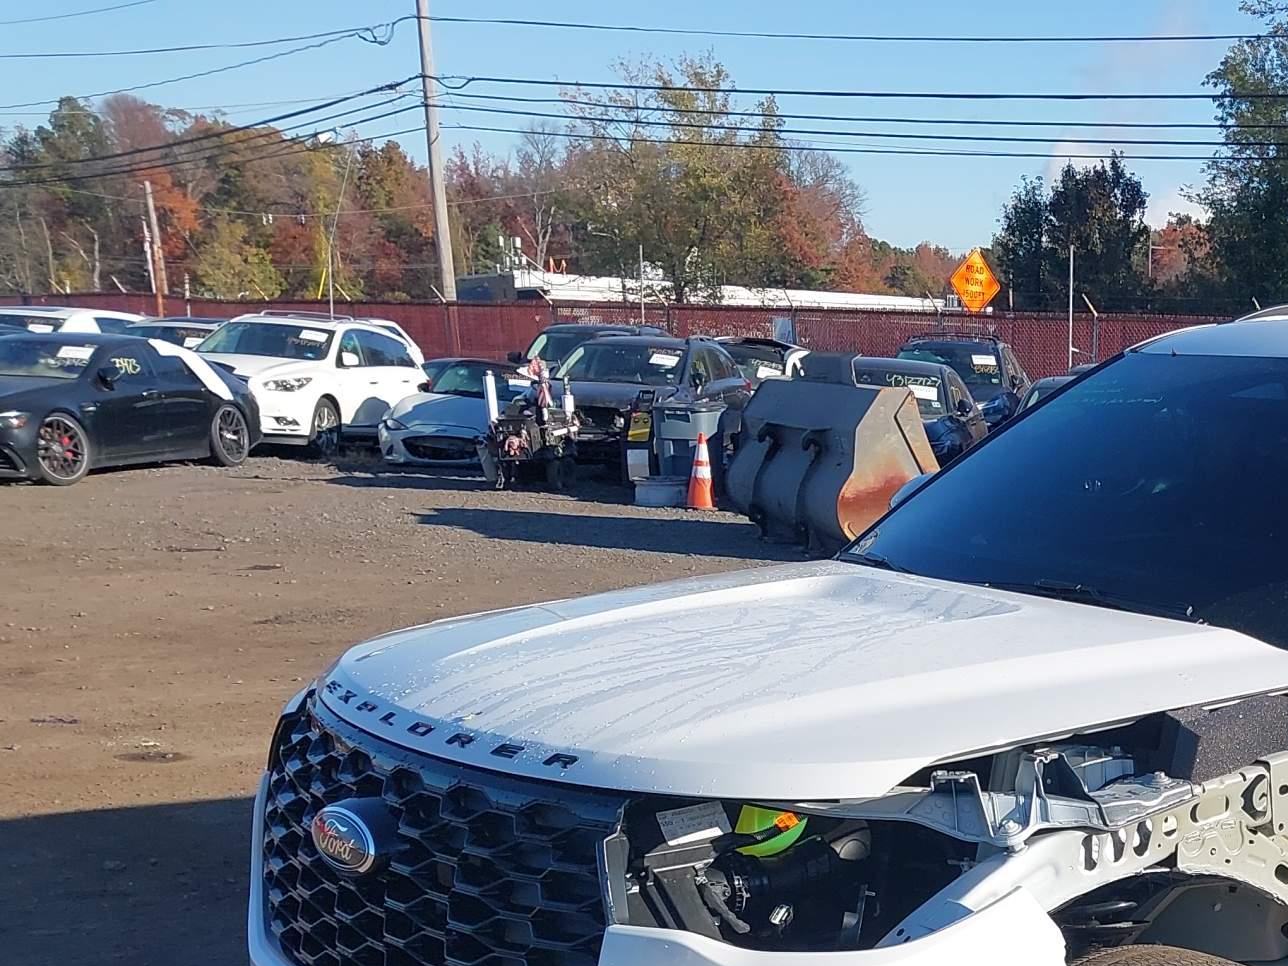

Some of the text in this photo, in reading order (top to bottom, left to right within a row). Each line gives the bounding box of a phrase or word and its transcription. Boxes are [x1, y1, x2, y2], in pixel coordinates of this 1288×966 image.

[965, 276, 984, 287] WORK
[966, 265, 984, 275] ROAD
[325, 679, 582, 771] EXPLORER
[318, 818, 355, 860] Ford
